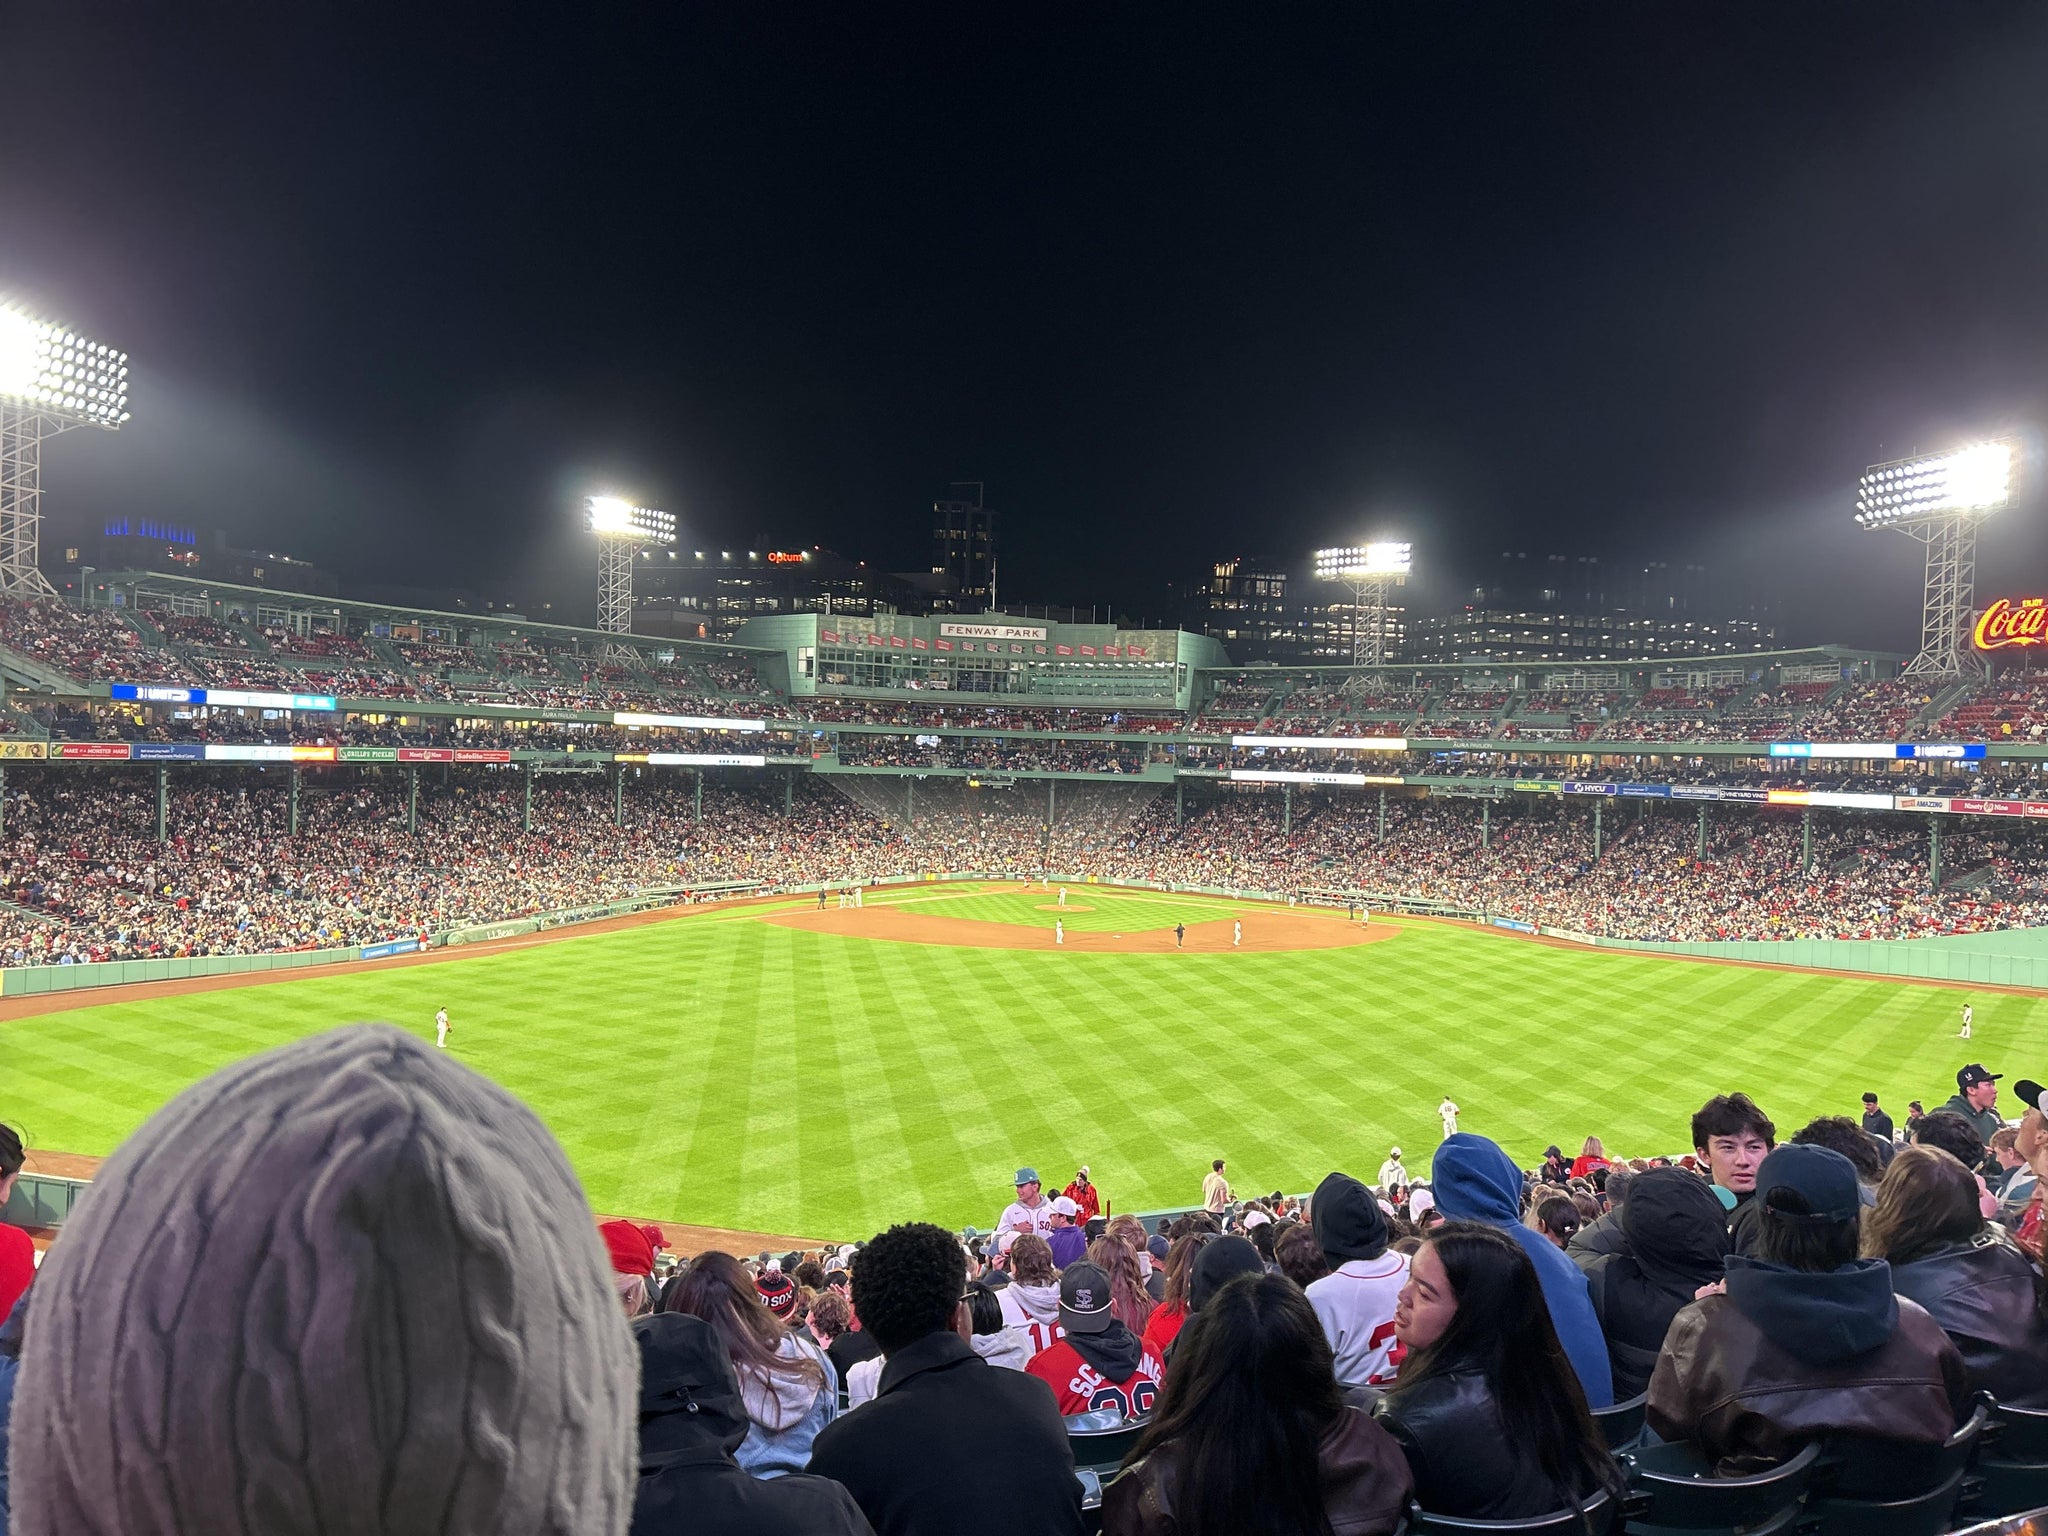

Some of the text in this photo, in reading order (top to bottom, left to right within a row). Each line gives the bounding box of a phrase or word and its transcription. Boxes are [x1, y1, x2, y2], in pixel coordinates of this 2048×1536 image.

[768, 552, 803, 564] Optum
[947, 626, 1039, 637] FENWAY PARK
[88, 748, 112, 756] MONSTER
[1584, 784, 1606, 792] HYCU
[1916, 800, 1943, 808] AMAZING
[1964, 802, 1983, 811] Ninety
[770, 1290, 793, 1307] SOX
